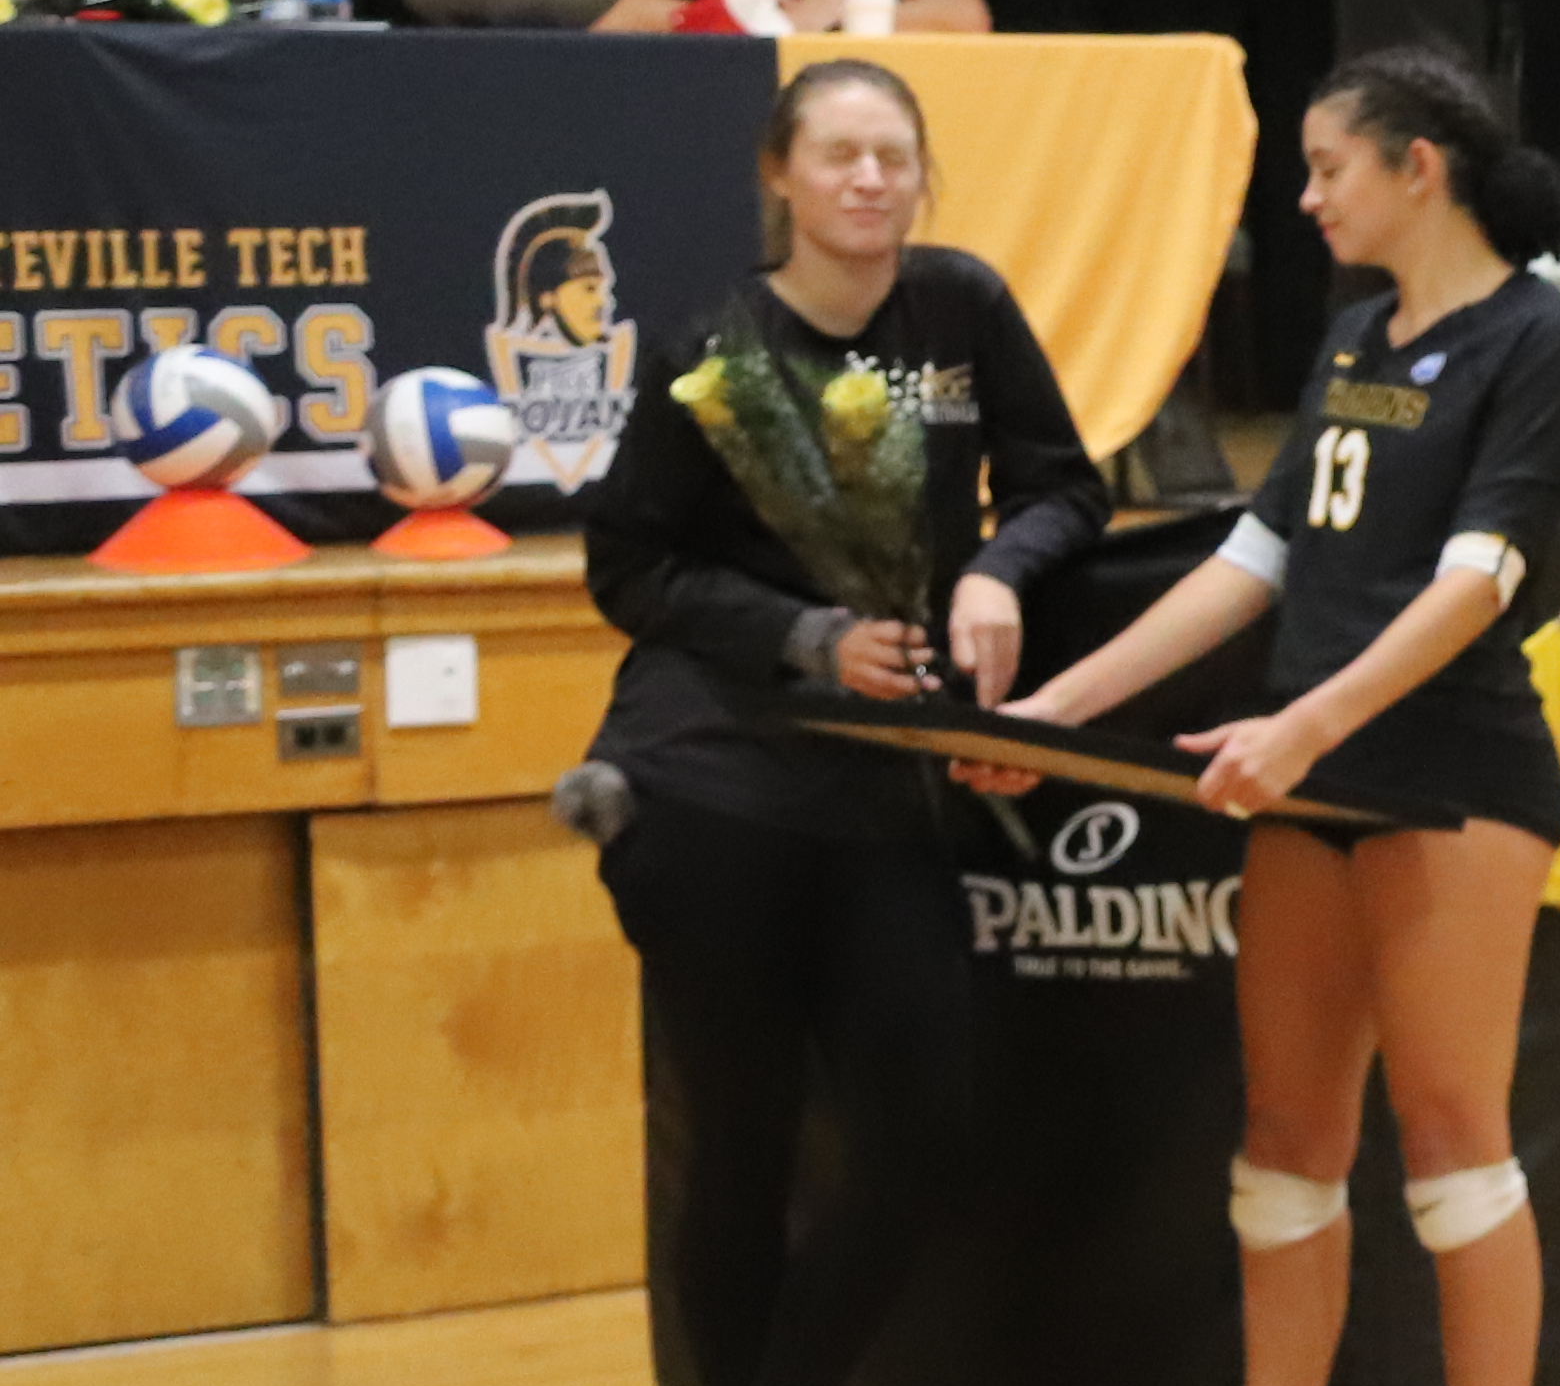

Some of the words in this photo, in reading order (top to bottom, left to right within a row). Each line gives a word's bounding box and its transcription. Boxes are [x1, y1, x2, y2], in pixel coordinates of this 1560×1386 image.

[0, 229, 207, 291] EVILLE
[226, 226, 369, 287] TECH
[1308, 426, 1371, 531] 13
